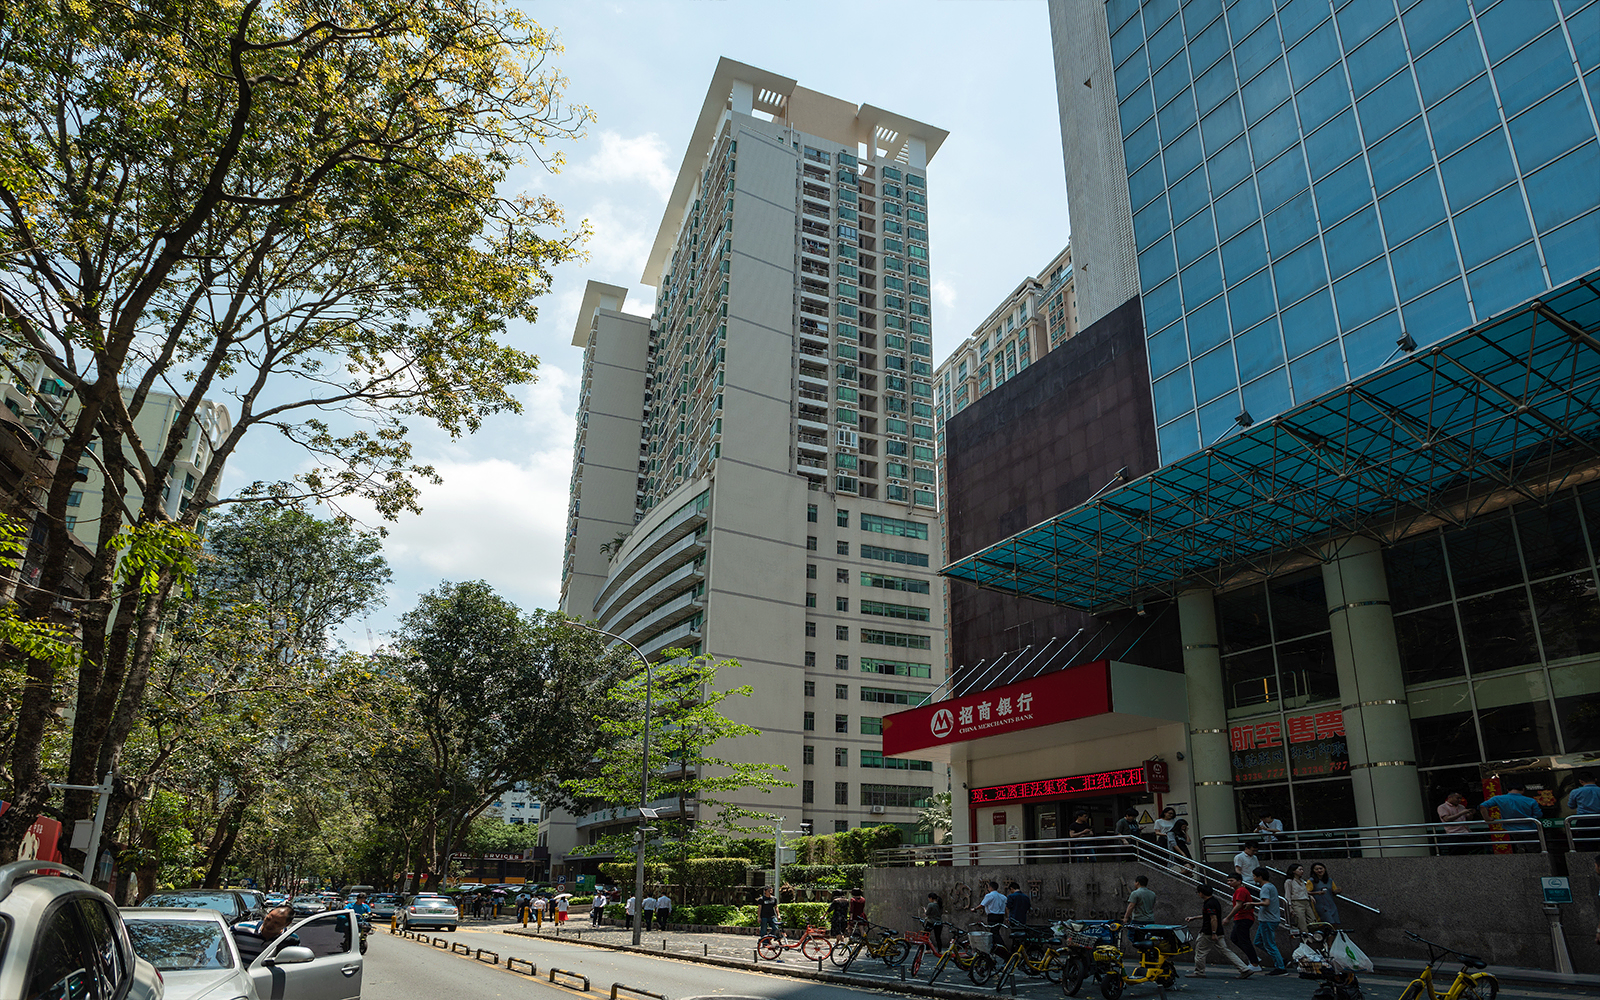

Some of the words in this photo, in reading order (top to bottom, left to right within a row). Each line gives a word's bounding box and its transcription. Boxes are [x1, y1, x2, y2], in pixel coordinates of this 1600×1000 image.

[958, 725, 977, 734] CHINA
[977, 717, 1015, 730] MERCHANTS
[1015, 713, 1034, 722] BANK
[1230, 709, 1346, 752] 航空售票
[1232, 749, 1285, 770] 电脑联网
[1290, 741, 1348, 763] 即订即取
[576, 875, 585, 883] P
